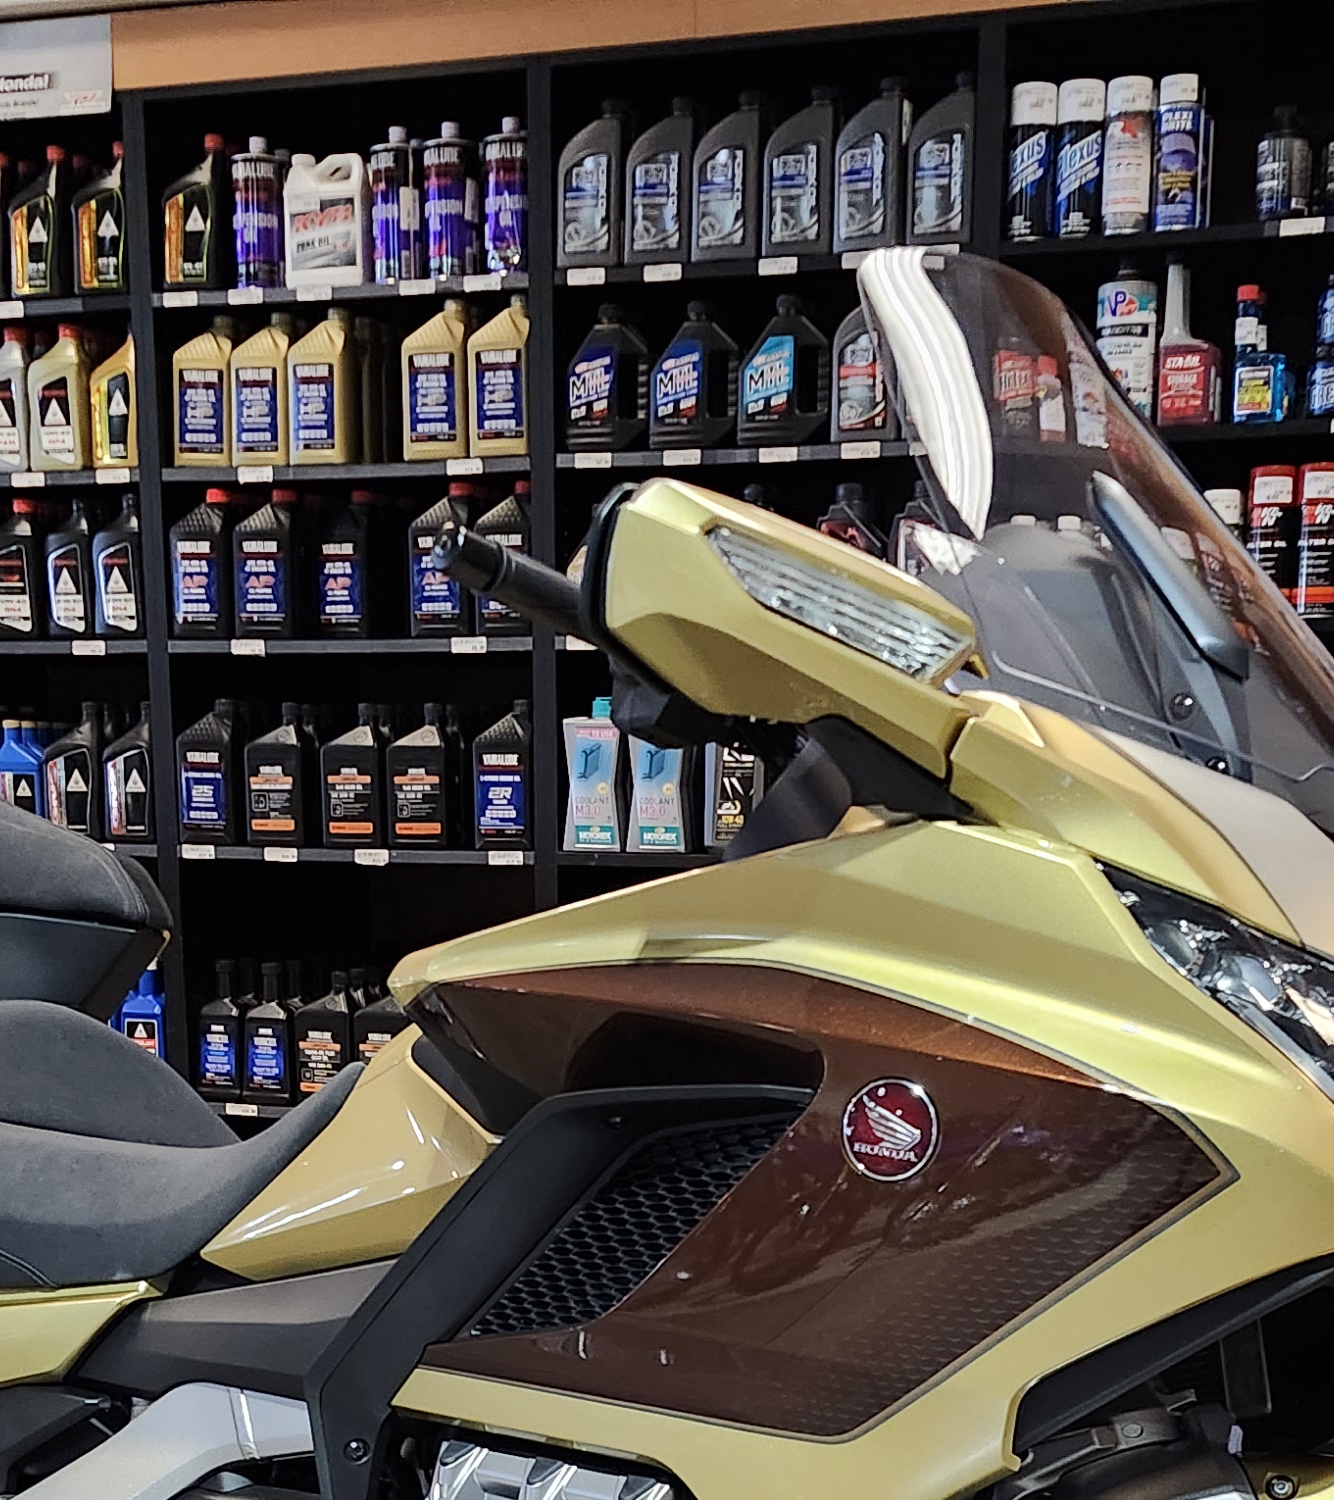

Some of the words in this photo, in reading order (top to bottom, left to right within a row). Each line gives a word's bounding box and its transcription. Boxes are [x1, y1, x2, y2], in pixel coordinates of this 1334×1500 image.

[1107, 290, 1127, 317] VP
[575, 797, 610, 805] COOLANT
[639, 797, 675, 806] COOLANT
[575, 805, 601, 816] M3.0
[639, 805, 667, 817] M3.0
[852, 1141, 919, 1163] HONDA
